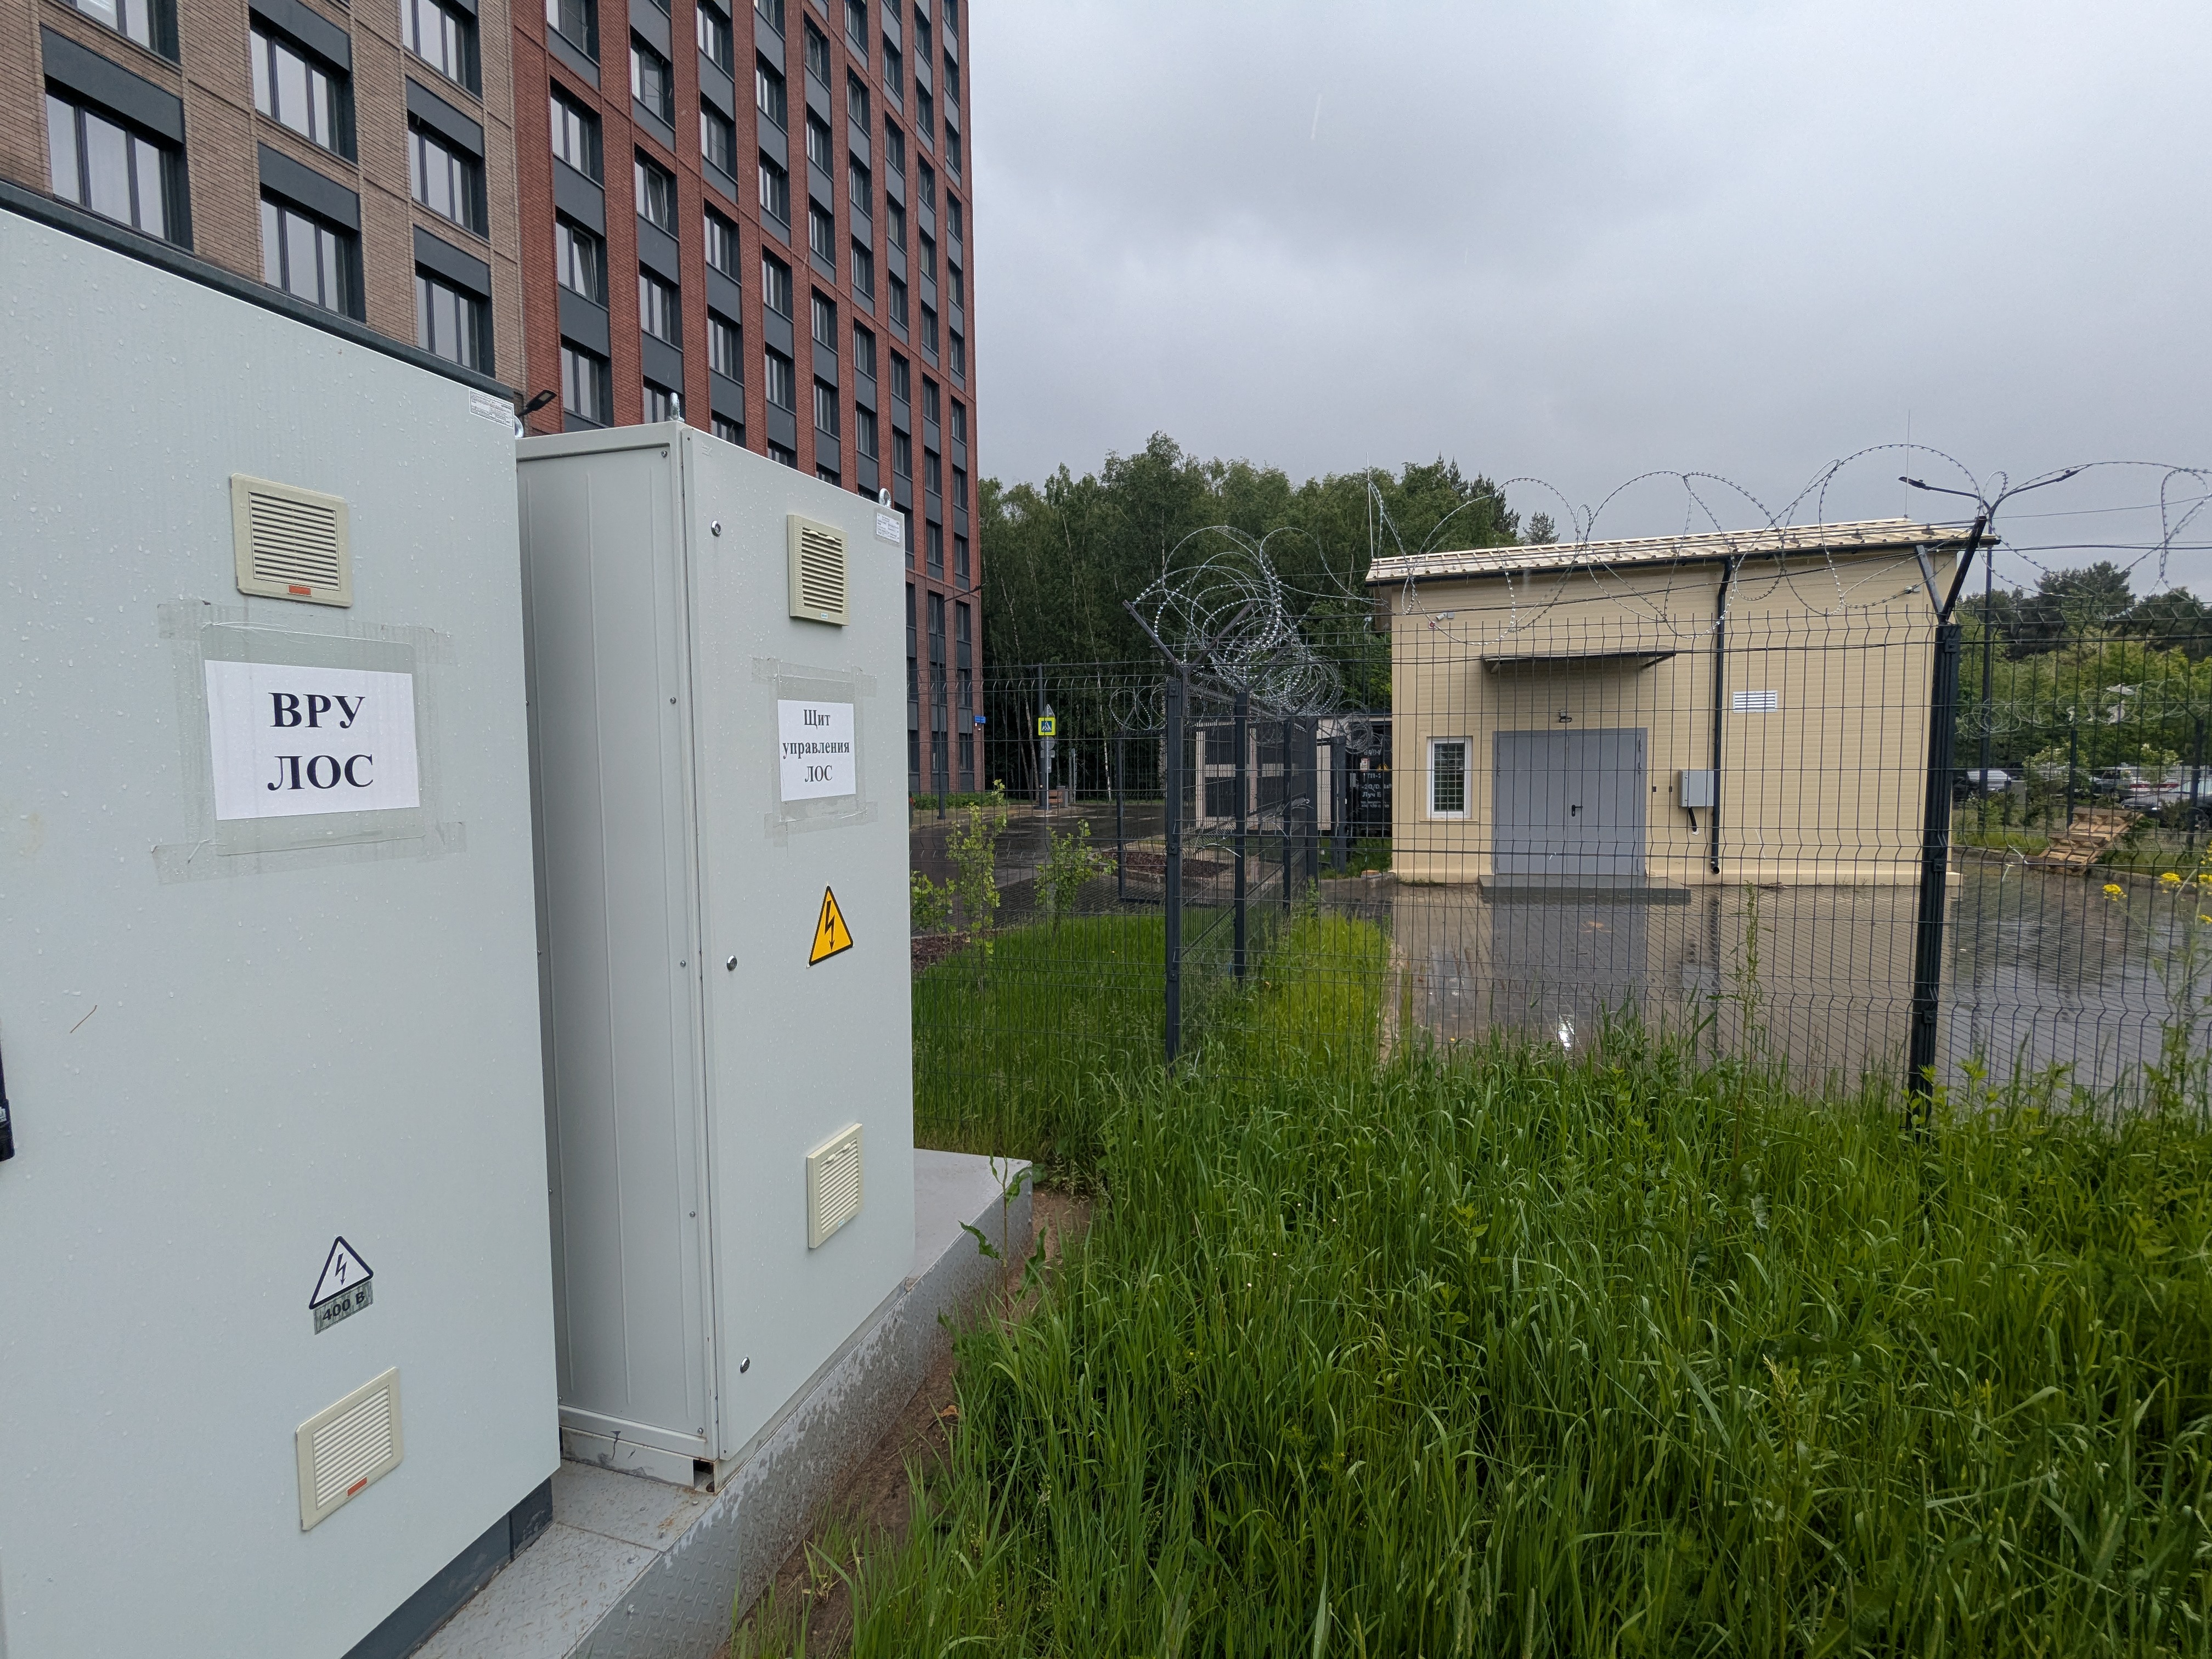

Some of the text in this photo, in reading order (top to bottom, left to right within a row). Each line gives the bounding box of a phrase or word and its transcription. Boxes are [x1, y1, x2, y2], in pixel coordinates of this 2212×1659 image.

[267, 692, 366, 729] ВРУ
[803, 709, 831, 730] Щит
[782, 741, 850, 759] управления
[267, 754, 374, 791] ЛОС
[804, 765, 833, 783] ЛОС
[323, 1291, 365, 1321] 400 В
